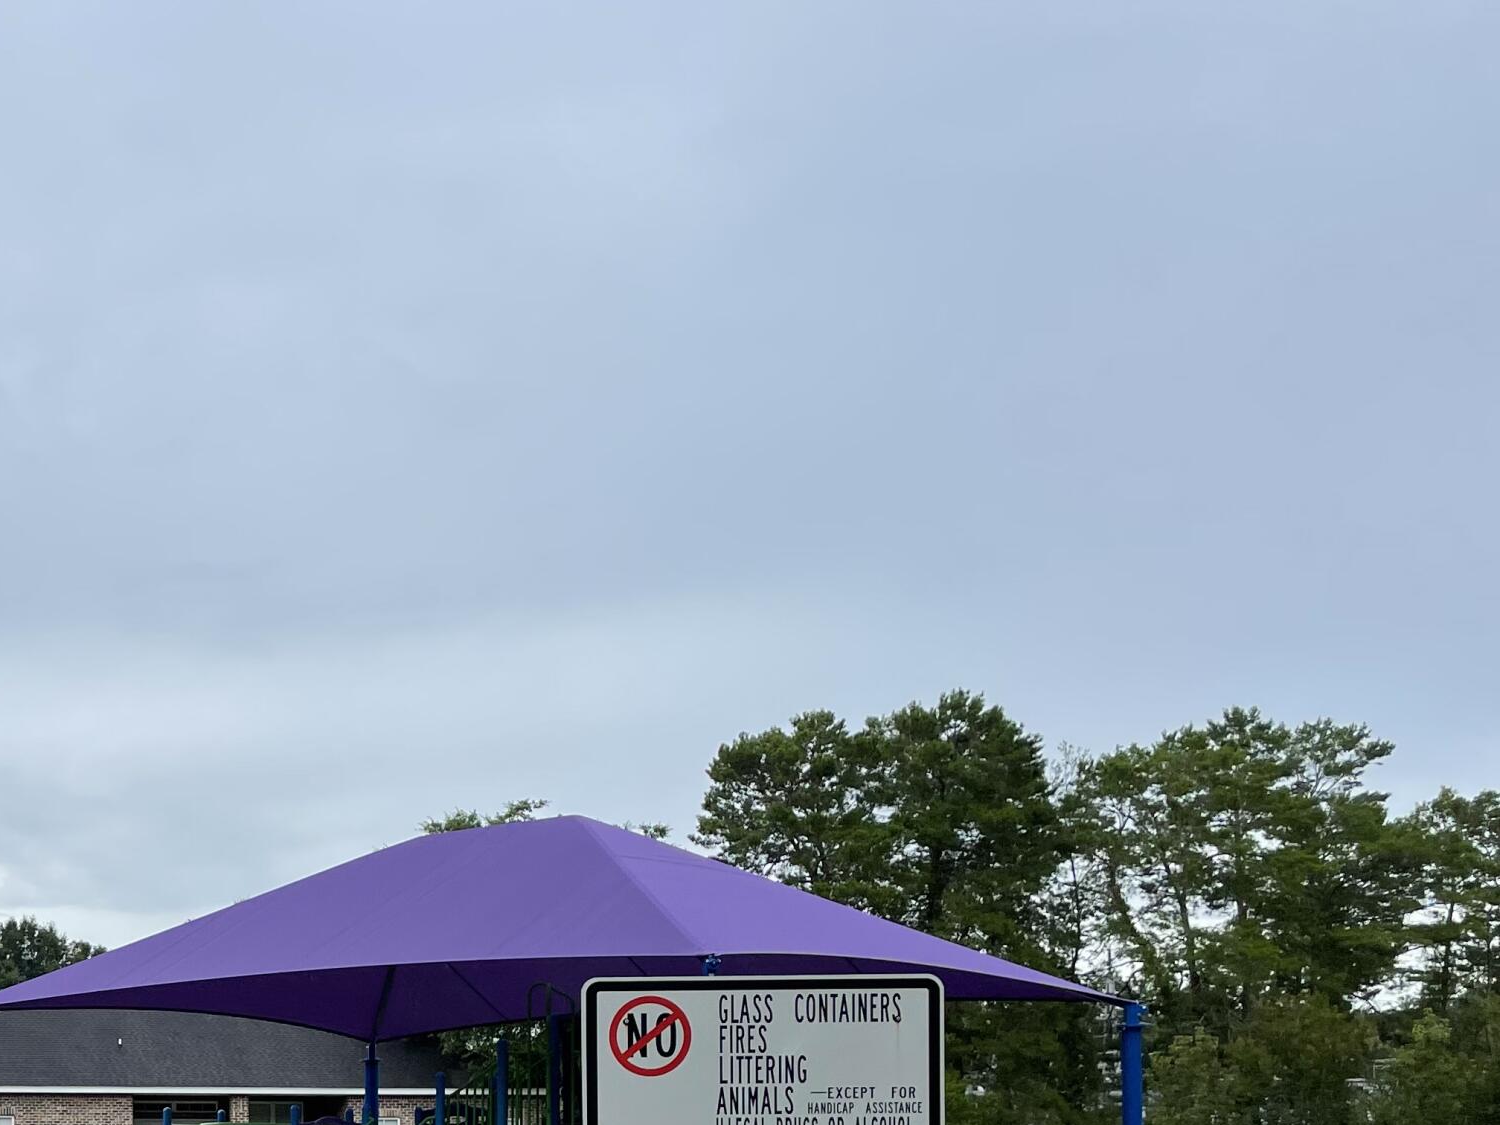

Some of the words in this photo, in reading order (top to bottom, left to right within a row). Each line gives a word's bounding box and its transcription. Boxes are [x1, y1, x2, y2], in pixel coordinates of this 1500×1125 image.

[719, 994, 773, 1023] GLASS
[795, 993, 902, 1023] CONTAINERS
[626, 1013, 677, 1058] NO
[719, 1025, 767, 1053] FIRES
[719, 1055, 807, 1083] LITTERING
[717, 1087, 794, 1115] ANIMALS
[891, 1087, 916, 1099] FOR
[808, 1102, 855, 1114] HANDICAP
[866, 1101, 923, 1113] ASSISTANCE
